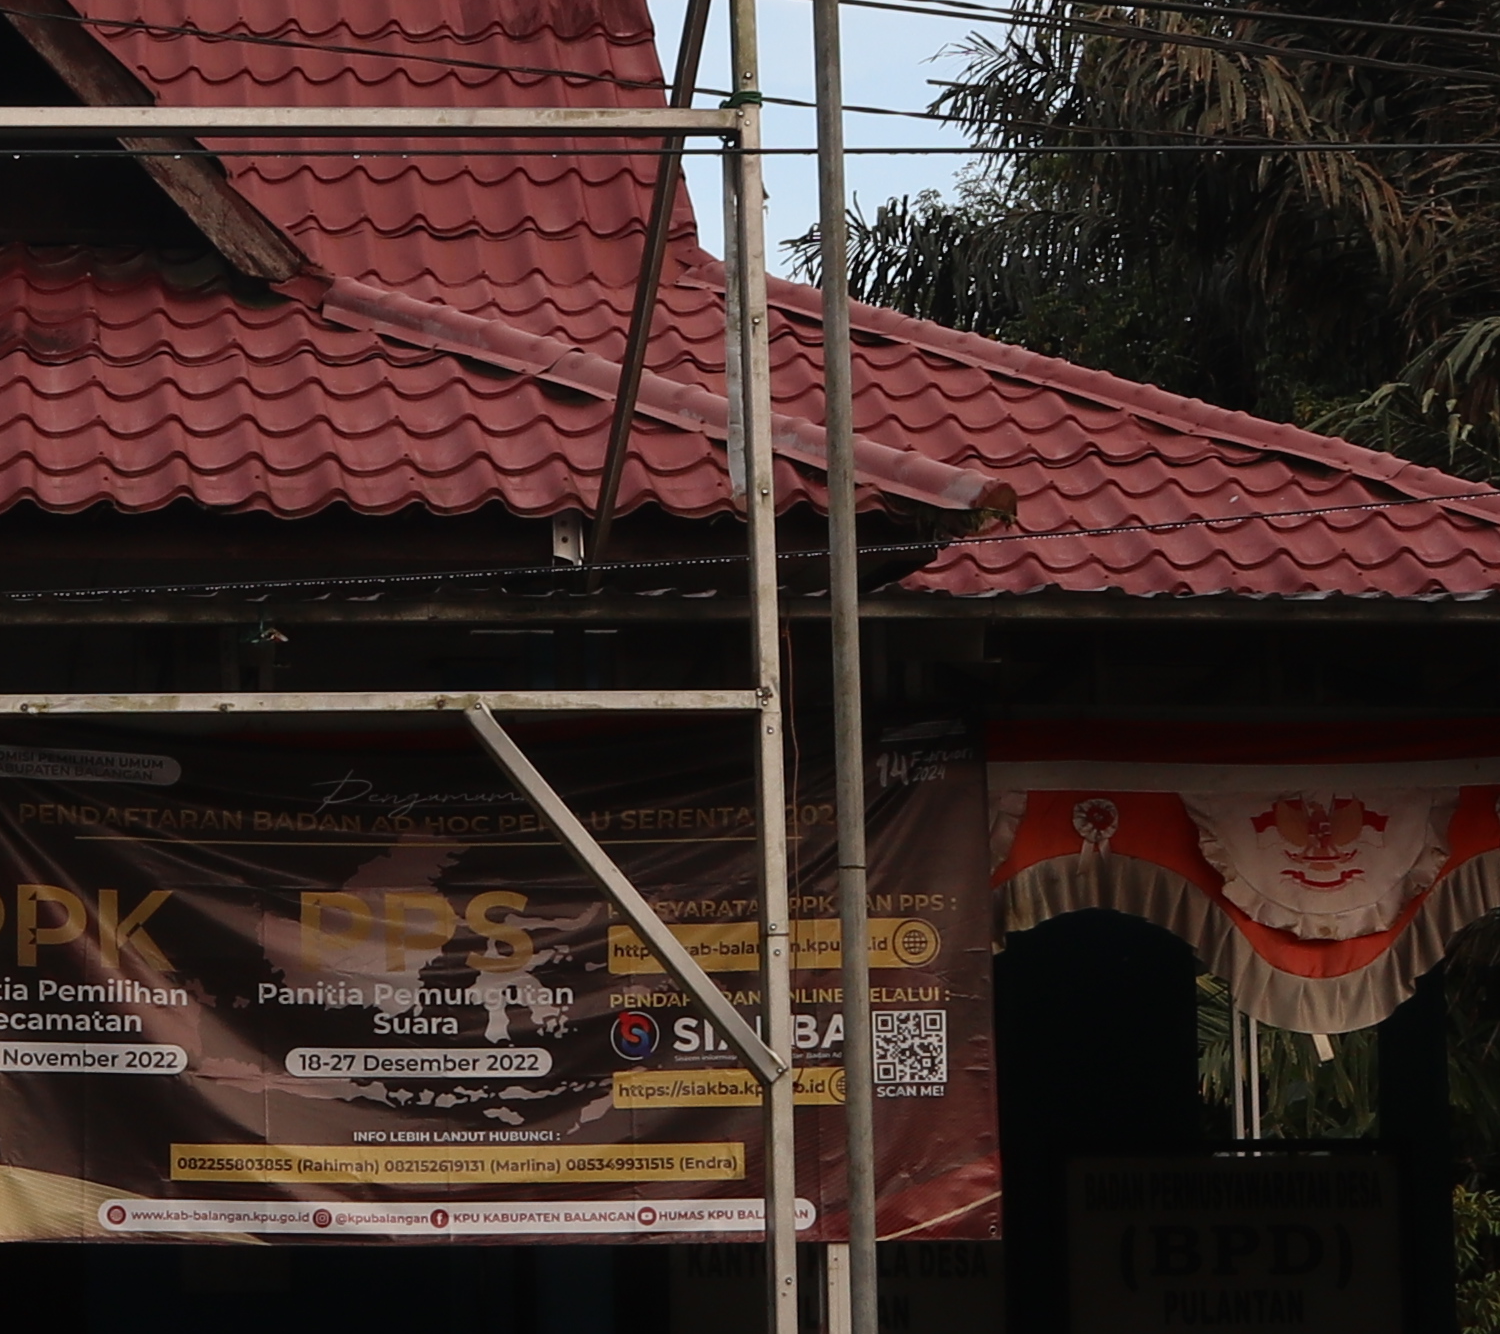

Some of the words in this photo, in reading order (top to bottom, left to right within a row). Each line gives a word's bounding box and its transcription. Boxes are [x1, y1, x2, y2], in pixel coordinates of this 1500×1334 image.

[38, 752, 115, 767] PEMILIHAN
[119, 757, 164, 769] UMUM
[876, 752, 909, 787] 14
[75, 766, 153, 780] BALANGAN
[912, 765, 946, 782] 2024
[18, 803, 243, 831] PENDAFTARAN
[253, 810, 360, 832] BADAN
[371, 814, 412, 833] AD
[425, 815, 490, 833] HOC
[620, 806, 756, 831] SERENTA
[899, 894, 944, 911] PPS
[300, 890, 535, 973] PPS
[38, 978, 188, 1007] Pemilihan
[257, 981, 364, 1006] Panitia
[373, 982, 575, 1012] Pemungutan
[870, 987, 940, 1003] ELALUI
[373, 1013, 459, 1036] Suara
[3, 1048, 119, 1068] November
[125, 1050, 178, 1069] 2022
[298, 1053, 356, 1071] 18-27
[362, 1053, 480, 1072] Desember
[485, 1054, 539, 1072] 2022
[876, 1085, 918, 1098] SCAN
[920, 1085, 945, 1097] ME!
[353, 1131, 387, 1142] INFO
[390, 1131, 430, 1142] LEBIH
[433, 1131, 487, 1142] LANJUT
[488, 1131, 553, 1142] HUBUNGI
[297, 1157, 380, 1175] (Rahimah)
[490, 1157, 561, 1175] (Marlina)
[679, 1155, 738, 1172] (Endra)
[1084, 1172, 1144, 1212] BADAN
[1150, 1170, 1332, 1210] PERMUSYAWARATAN
[1336, 1170, 1383, 1209] DESA
[131, 1208, 311, 1224] www.kab-balangan.kpu.go.id
[335, 1211, 429, 1227] @kpubalangan
[453, 1212, 481, 1224] KPU
[483, 1212, 561, 1223] KABUPATEN
[564, 1211, 636, 1223] BALANGAN
[659, 1210, 705, 1221] HUMAS
[708, 1209, 734, 1221] KPU
[918, 1243, 988, 1279] DESA
[1164, 1288, 1305, 1326] PULANTAN
